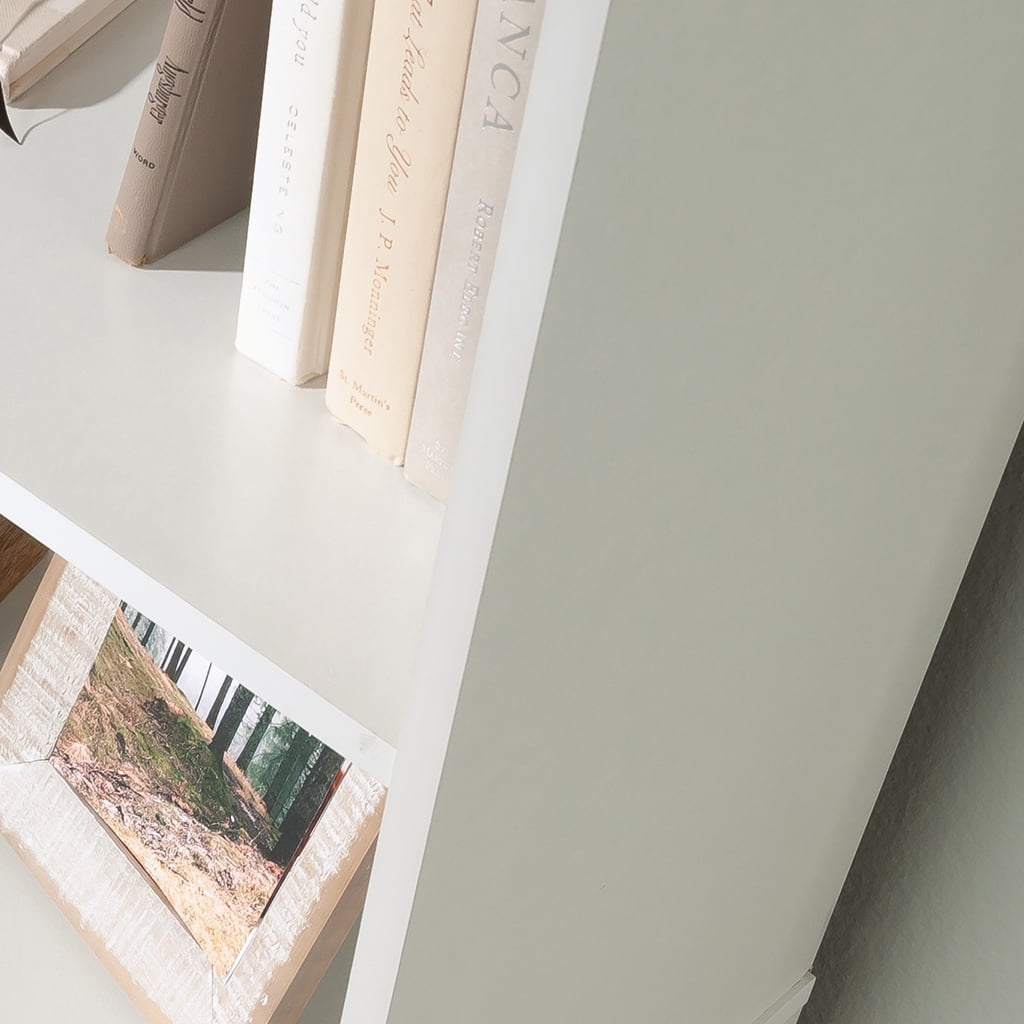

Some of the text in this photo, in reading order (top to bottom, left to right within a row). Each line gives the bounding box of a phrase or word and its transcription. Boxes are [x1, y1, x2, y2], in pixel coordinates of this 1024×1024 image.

[292, 17, 309, 66] you
[399, 27, 425, 105] Leads
[481, 0, 536, 131] NCA
[395, 106, 410, 133] to
[133, 147, 156, 170] WORD
[278, 104, 299, 197] CELESTE
[386, 133, 412, 193] You
[362, 207, 396, 356] J. P. Monninger
[352, 379, 391, 412] Martin's
